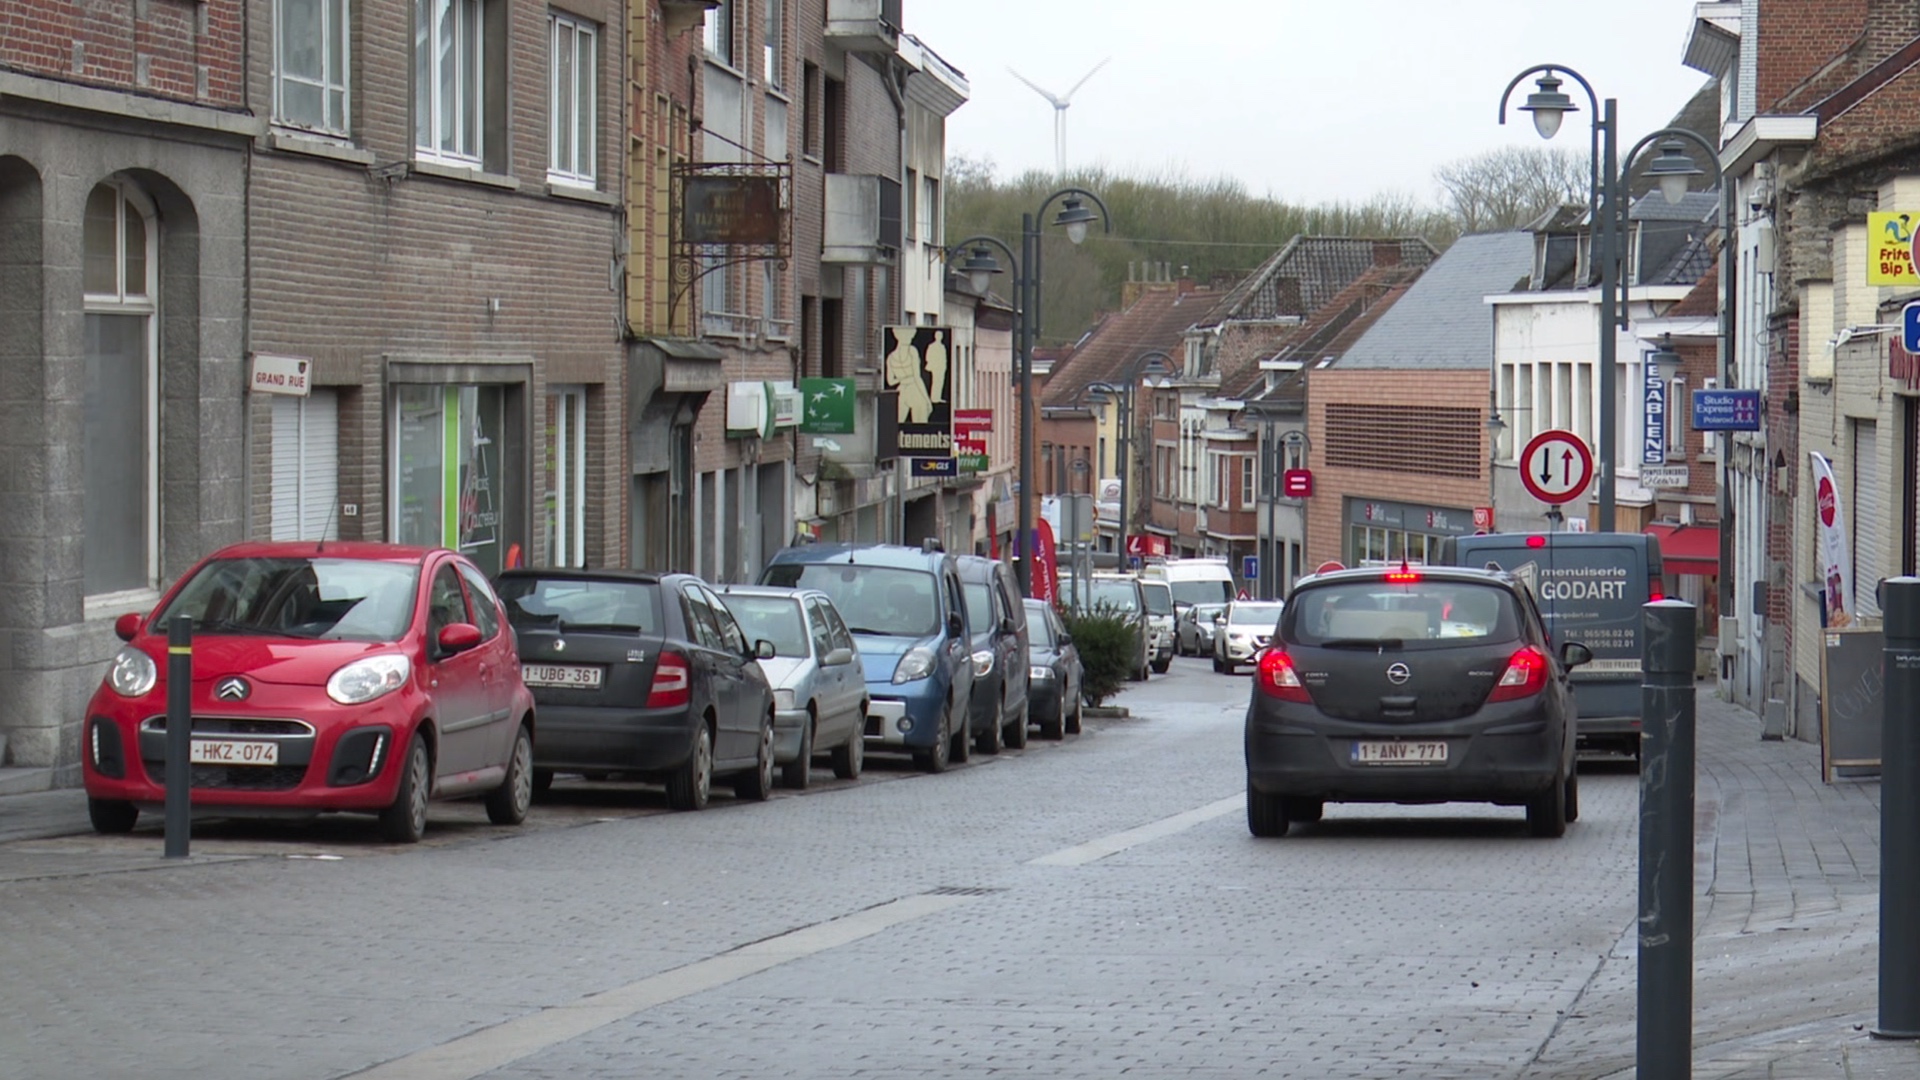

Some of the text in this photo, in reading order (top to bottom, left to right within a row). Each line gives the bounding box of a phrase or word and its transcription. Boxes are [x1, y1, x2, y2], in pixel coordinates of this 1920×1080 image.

[1880, 248, 1911, 261] Frite
[1880, 261, 1903, 277] Bip
[256, 372, 305, 388] GRAND RUE
[1703, 395, 1734, 405] Studio
[1696, 403, 1734, 414] Express
[898, 430, 950, 449] tements
[936, 462, 949, 471] GLS
[1541, 566, 1627, 577] menuiserie
[1541, 580, 1627, 600] GODART
[525, 667, 599, 683] 1-UBG-361
[194, 743, 273, 761] -HKZ-074
[1361, 743, 1446, 760] 1-ANV-771
